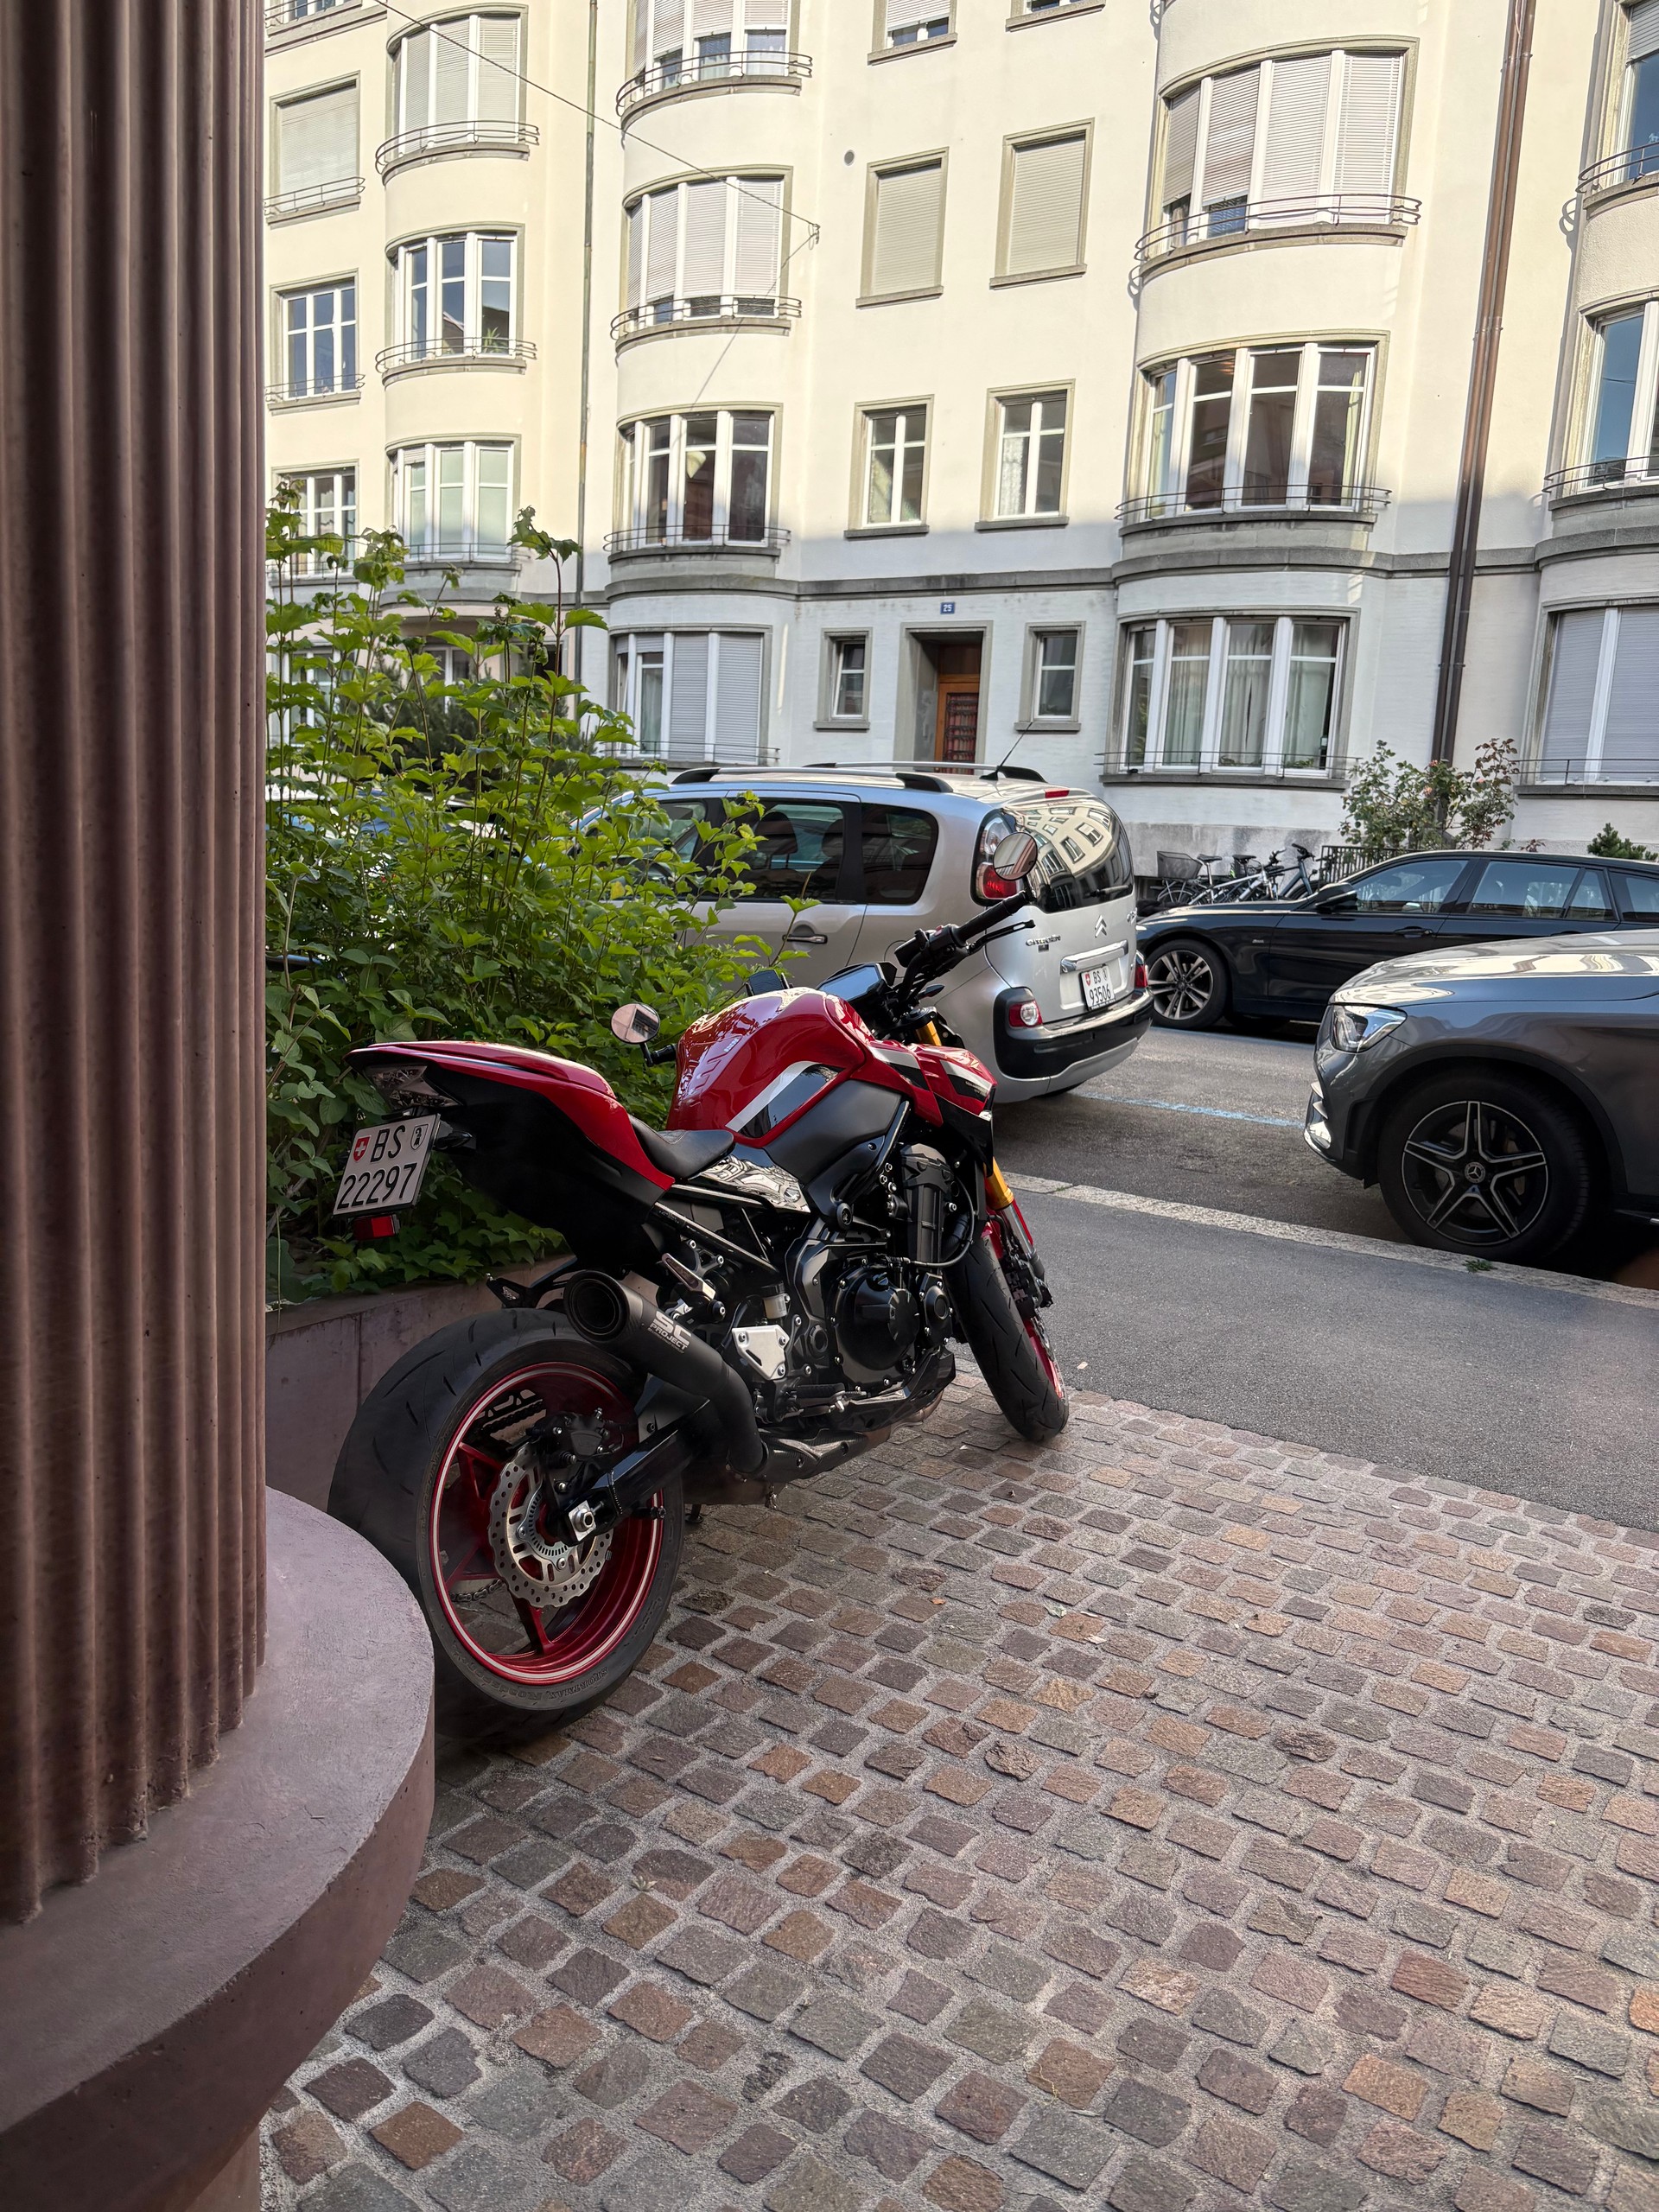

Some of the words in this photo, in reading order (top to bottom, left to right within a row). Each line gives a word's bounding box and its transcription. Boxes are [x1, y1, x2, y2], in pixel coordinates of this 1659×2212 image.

[1092, 970, 1102, 984] BS
[1089, 983, 1111, 1006] 93506
[370, 1124, 406, 1163] BS
[336, 1162, 418, 1210] 22297
[649, 1322, 688, 1351] PROJECT
[652, 1310, 691, 1346] SC
